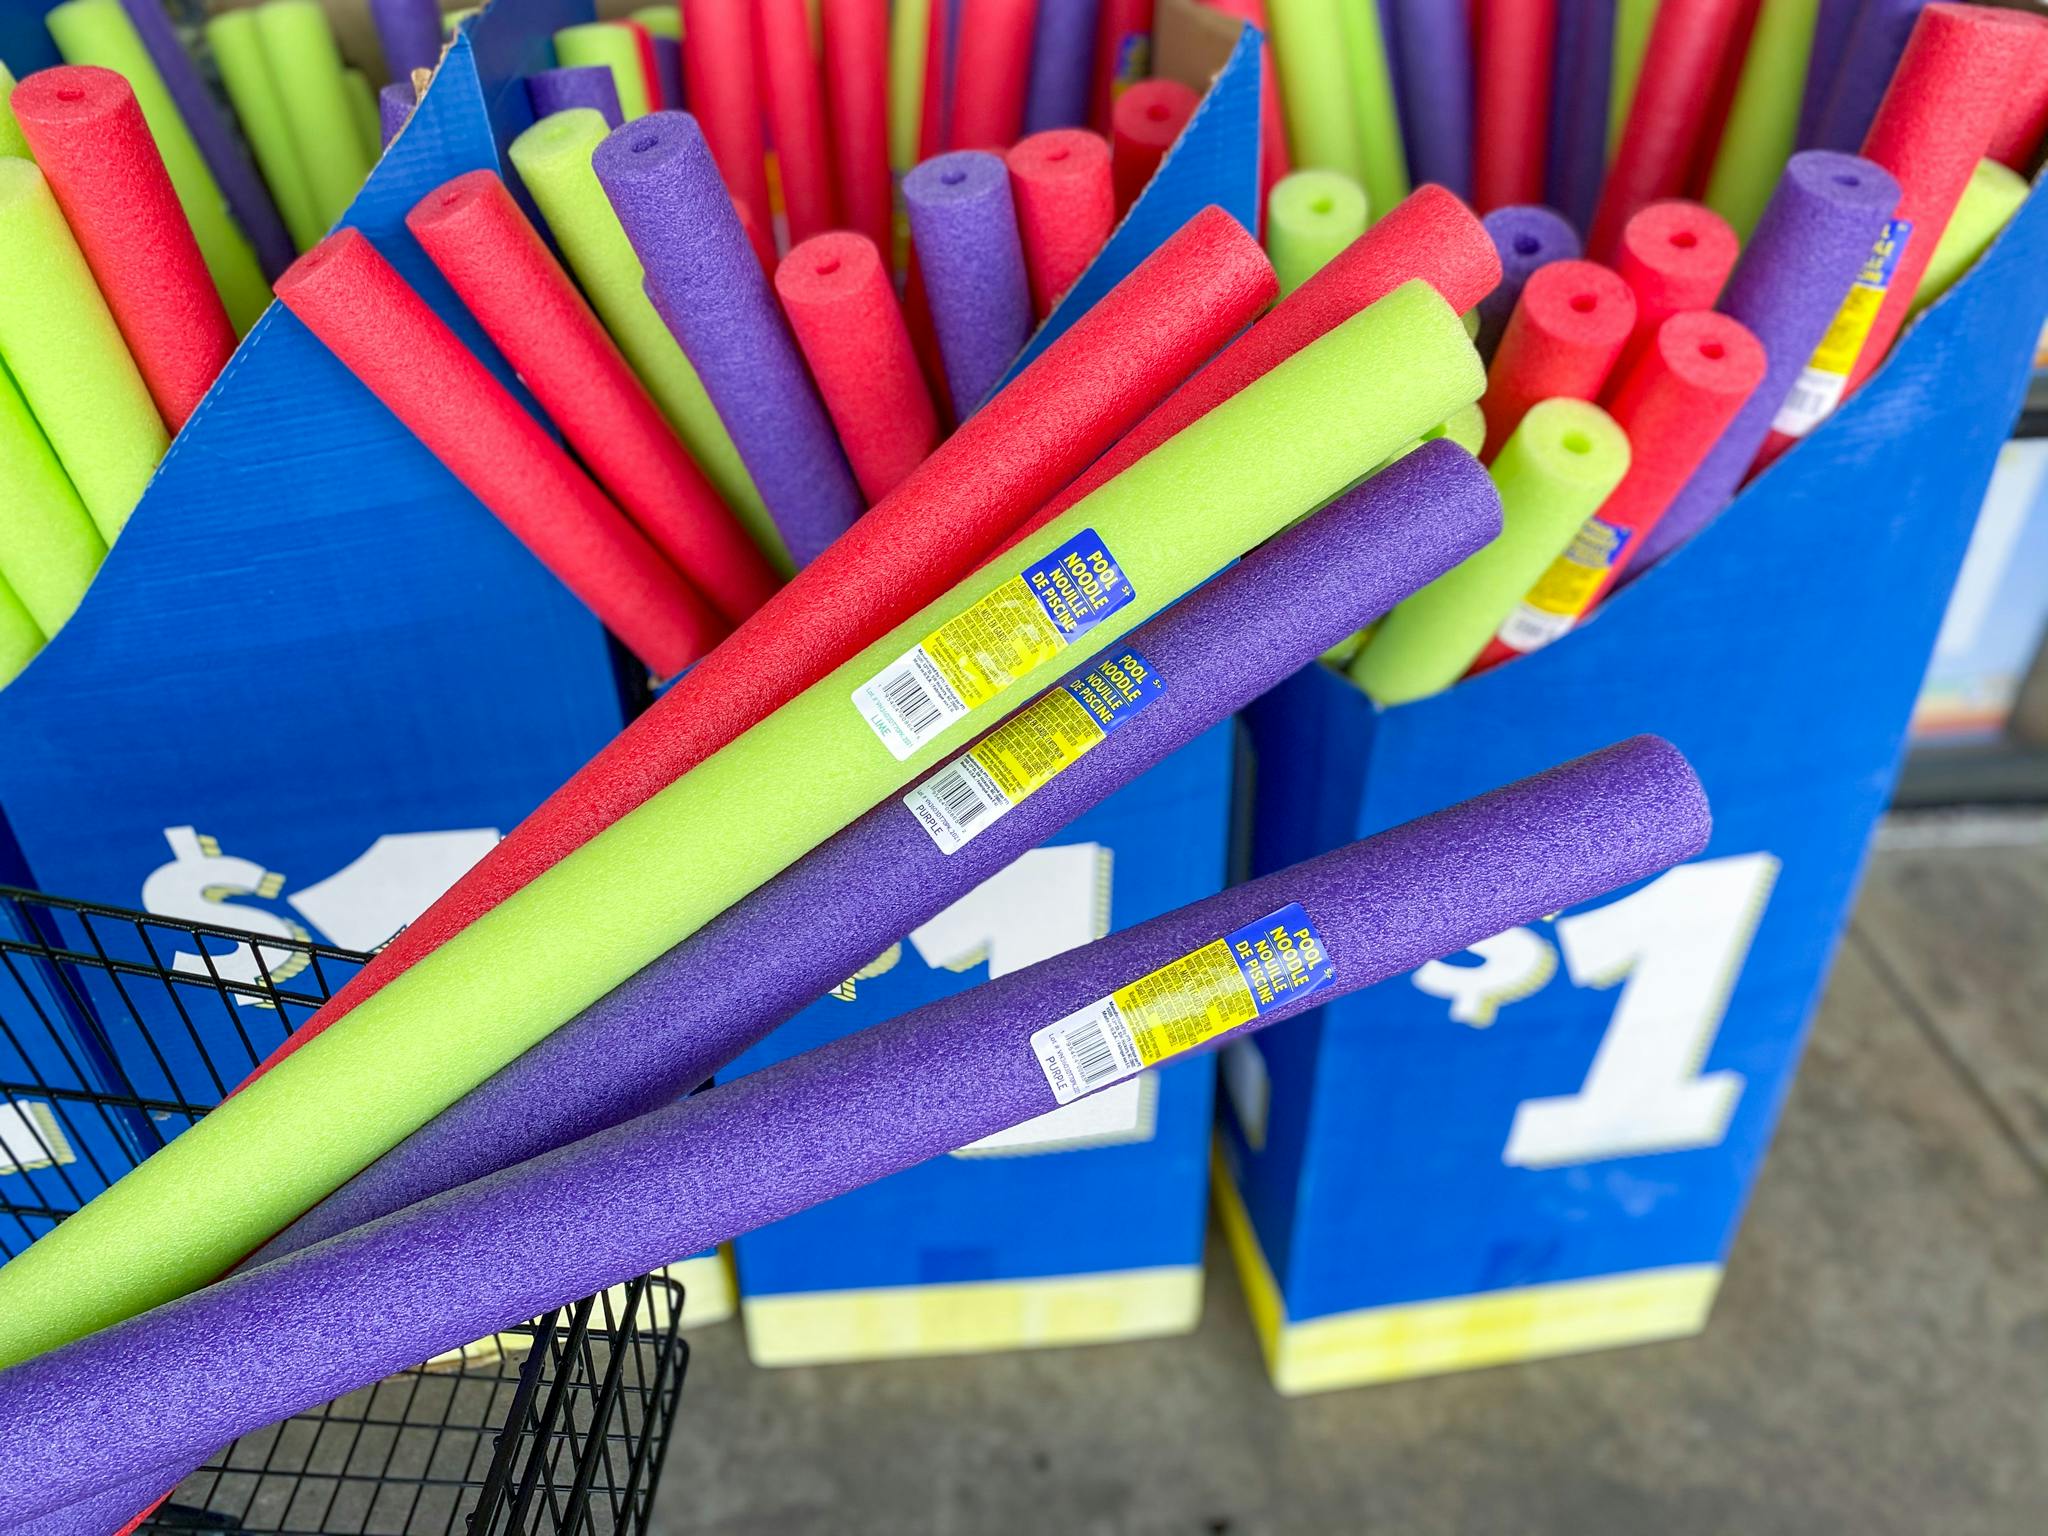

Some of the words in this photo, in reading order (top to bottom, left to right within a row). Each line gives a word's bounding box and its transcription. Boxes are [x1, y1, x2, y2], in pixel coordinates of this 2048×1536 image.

[1064, 552, 1109, 610] NOODLE
[1087, 550, 1118, 591] POOL
[1121, 585, 1131, 596] 5+
[1031, 571, 1050, 590] DE
[1042, 587, 1078, 632] PISCINE
[1049, 568, 1088, 618] NOUILLE
[1099, 660, 1142, 702] NOODLE
[1118, 655, 1148, 684] POOL
[1152, 679, 1161, 689] 5+
[1070, 680, 1085, 692] DE
[1079, 688, 1114, 724] PISCINE
[1085, 673, 1123, 710] NOUILLE
[871, 714, 891, 737] LIME
[916, 805, 943, 836] PURPLE
[1254, 940, 1288, 993] NOUILLE
[1270, 926, 1310, 987] NOODLE
[1293, 928, 1323, 971] POOL
[1235, 940, 1254, 960] DE
[1245, 958, 1274, 1005] PISCINE
[1045, 1056, 1067, 1090] PURPLE
